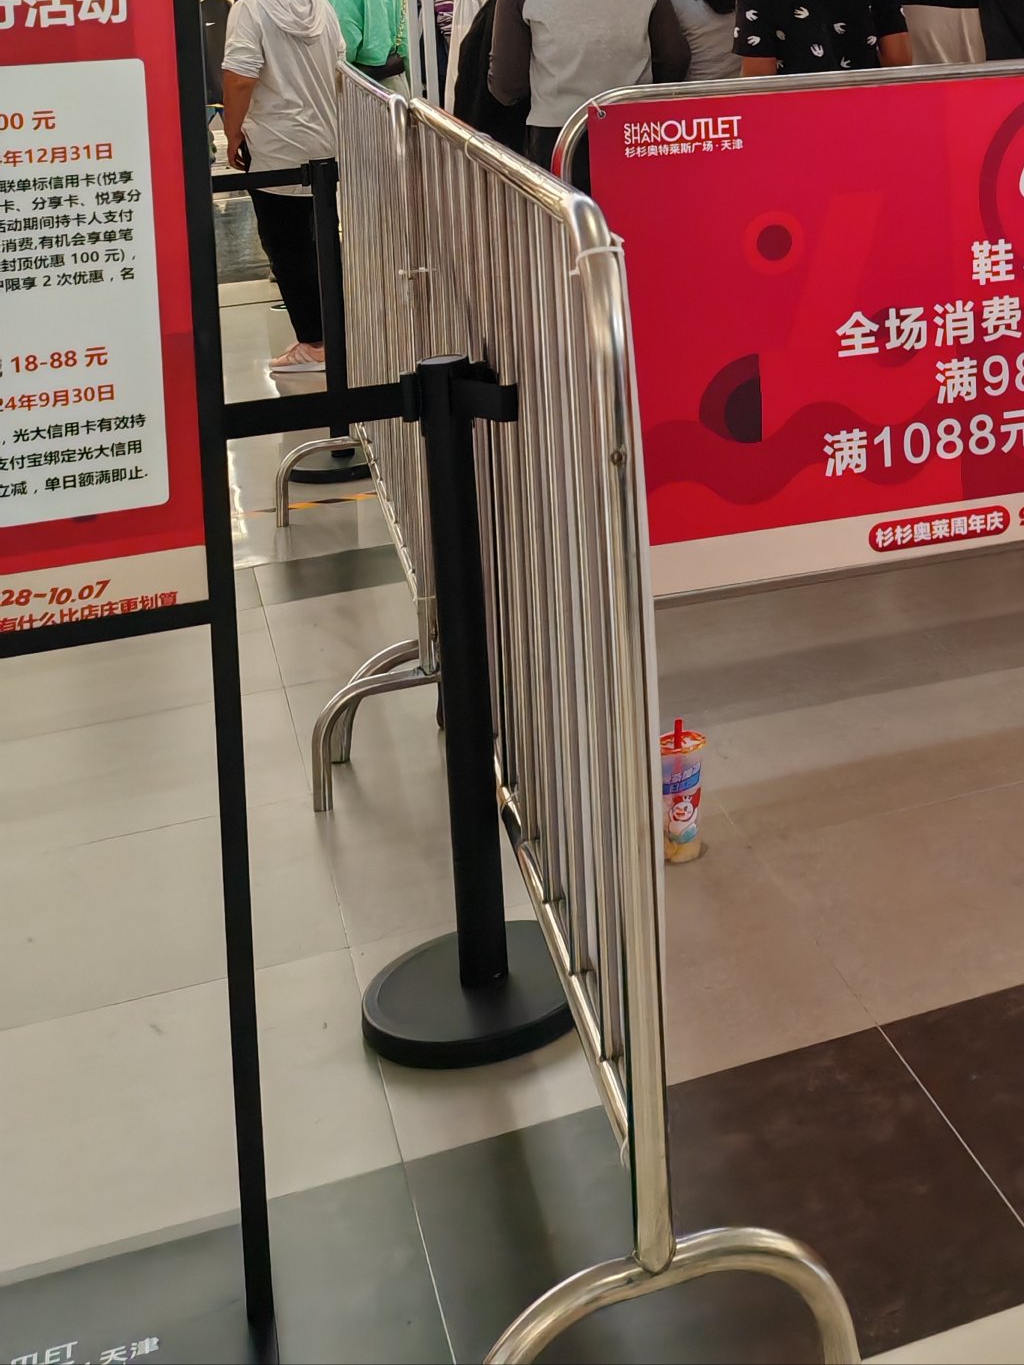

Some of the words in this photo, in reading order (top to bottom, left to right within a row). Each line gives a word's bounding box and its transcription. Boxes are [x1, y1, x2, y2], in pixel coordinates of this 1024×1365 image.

[32, 110, 56, 130] 元
[624, 121, 660, 135] SHAN
[661, 116, 742, 142] OUTLET
[625, 132, 660, 145] SHAN
[0, 143, 113, 167] 年12月31日
[71, 251, 100, 265] 100
[42, 275, 52, 287] 2
[11, 350, 78, 373] 18-88
[84, 346, 109, 367] 元
[875, 510, 1005, 549] 杉杉奥莱周年庆
